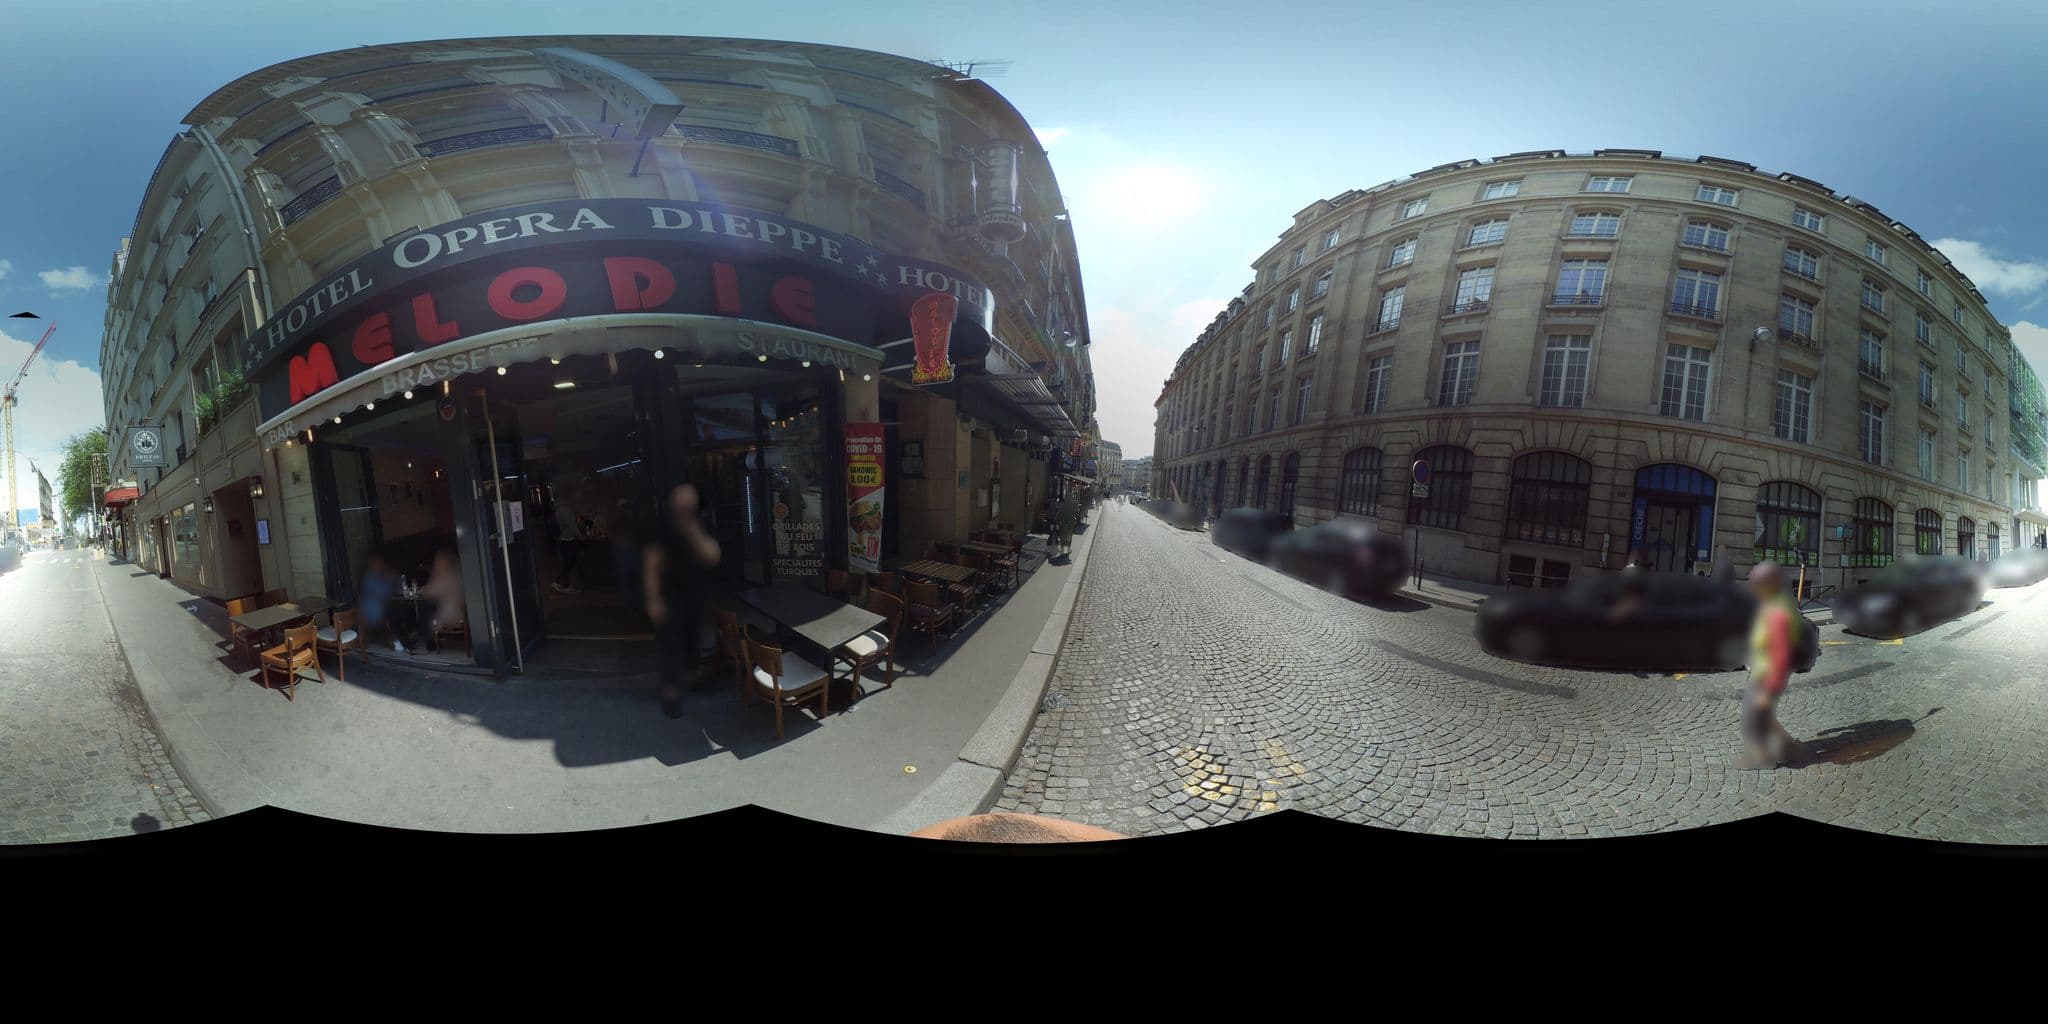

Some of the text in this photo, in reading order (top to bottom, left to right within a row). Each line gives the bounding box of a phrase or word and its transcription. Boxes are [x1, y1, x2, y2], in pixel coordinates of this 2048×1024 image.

[267, 206, 844, 350] HOTEL OPERA DIEPPE
[896, 265, 986, 309] HOTEL
[288, 256, 817, 405] MELODIE
[268, 419, 297, 447] BAR
[846, 444, 868, 453] COVID
[874, 444, 882, 453] 19
[772, 521, 821, 531] GRILLADES
[796, 532, 813, 541] FEU
[793, 543, 815, 551] BOIS
[776, 567, 818, 576] TURQUES
